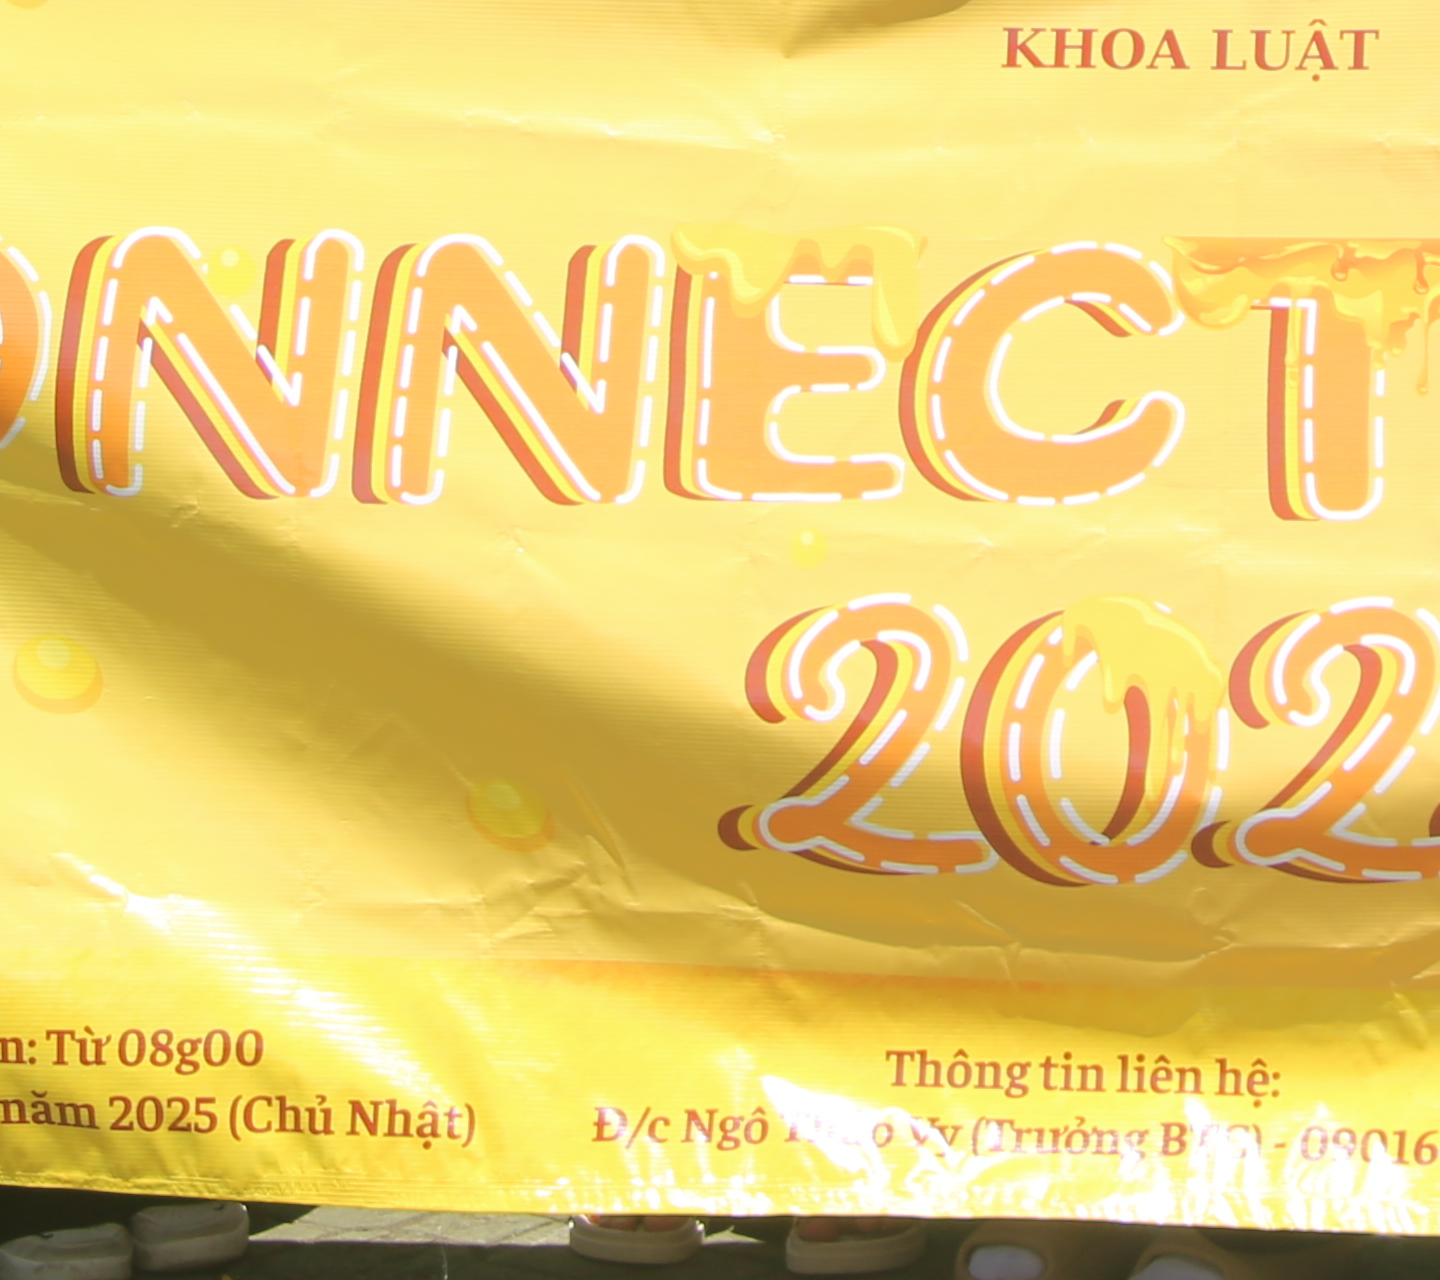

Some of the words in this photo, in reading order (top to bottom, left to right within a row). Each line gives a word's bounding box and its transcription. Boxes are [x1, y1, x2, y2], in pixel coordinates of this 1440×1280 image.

[1001, 26, 1190, 70] KHOA
[1211, 18, 1380, 83] LUẬT
[45, 1027, 112, 1068] Từ
[117, 1026, 264, 1078] 08g00
[884, 1048, 1031, 1099] Thông
[1039, 1051, 1105, 1093] tin
[1116, 1051, 1205, 1095] liên
[1215, 1055, 1283, 1109] hệ:
[108, 1095, 218, 1137] 2025
[227, 1094, 336, 1142] (Chủ
[345, 1096, 478, 1151] Nhật)
[592, 1104, 670, 1148] Đ/c
[681, 1104, 769, 1151] Ngô
